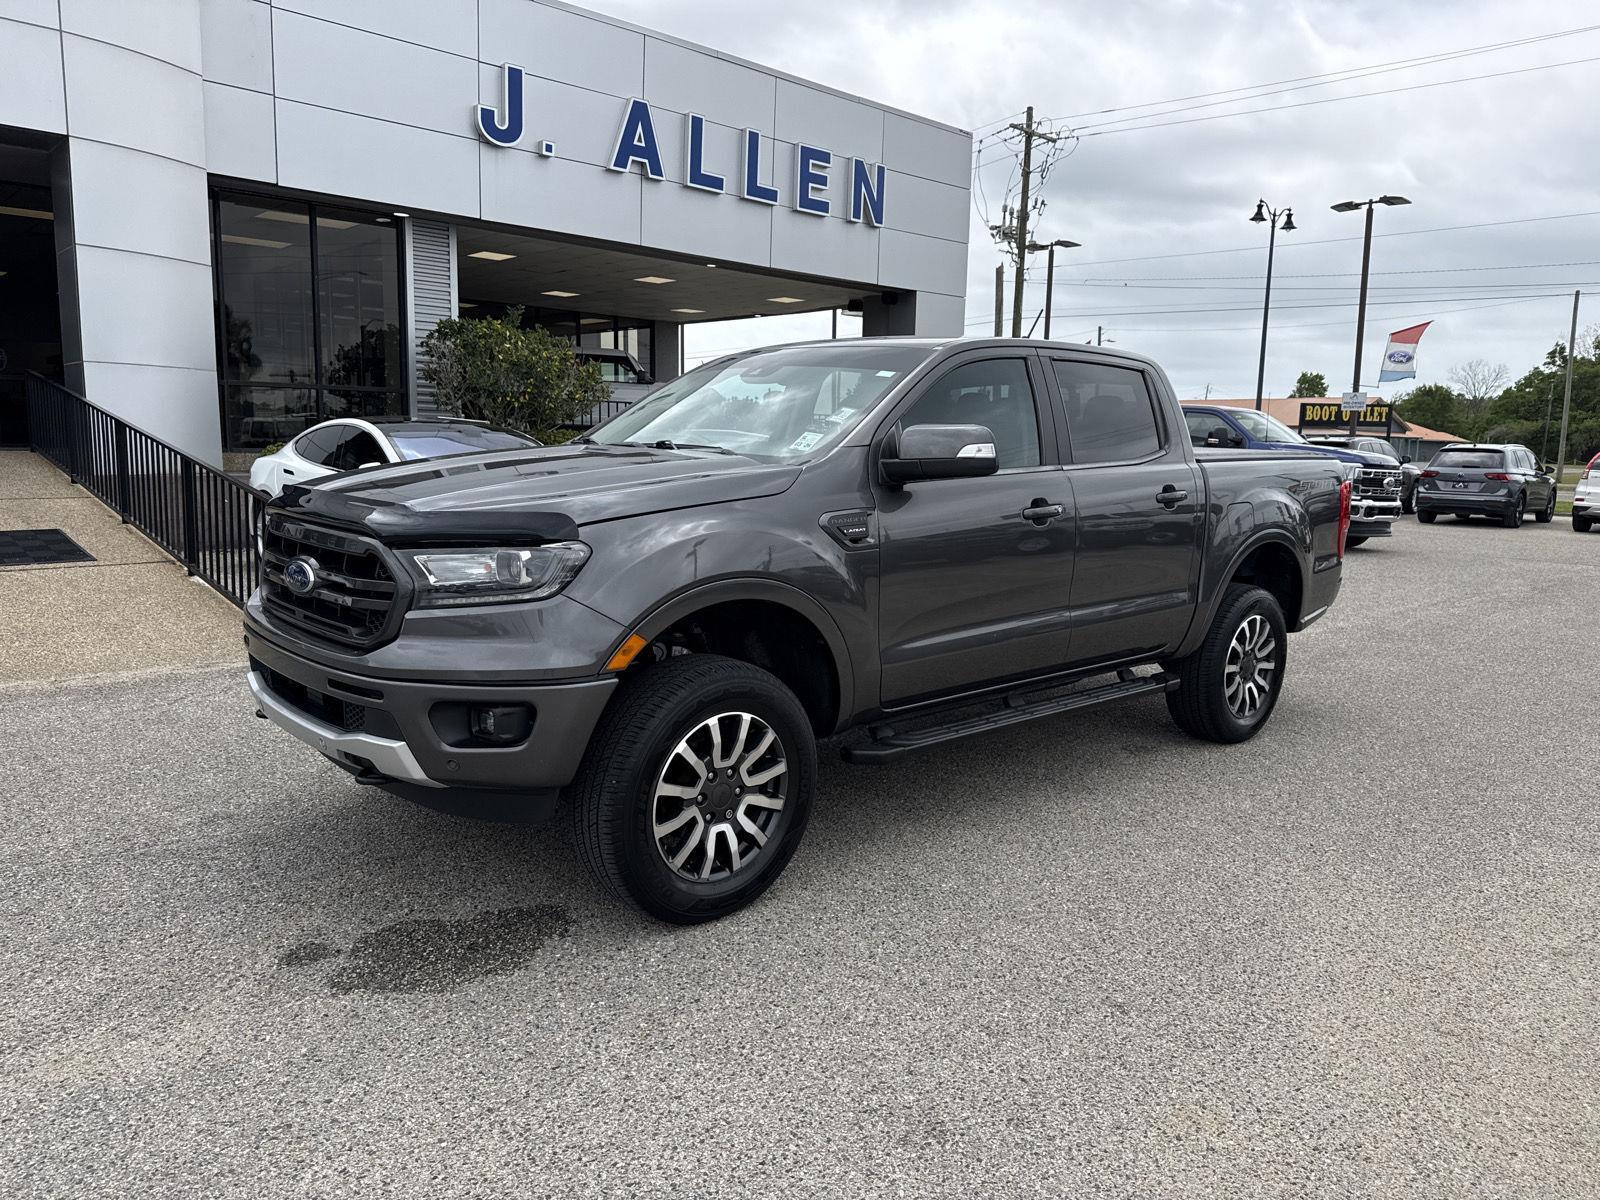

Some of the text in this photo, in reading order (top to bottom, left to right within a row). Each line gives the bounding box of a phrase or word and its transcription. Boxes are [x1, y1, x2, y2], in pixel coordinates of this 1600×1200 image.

[475, 63, 887, 227] J. ALLEN
[1305, 405, 1389, 421] BOOT OTLET
